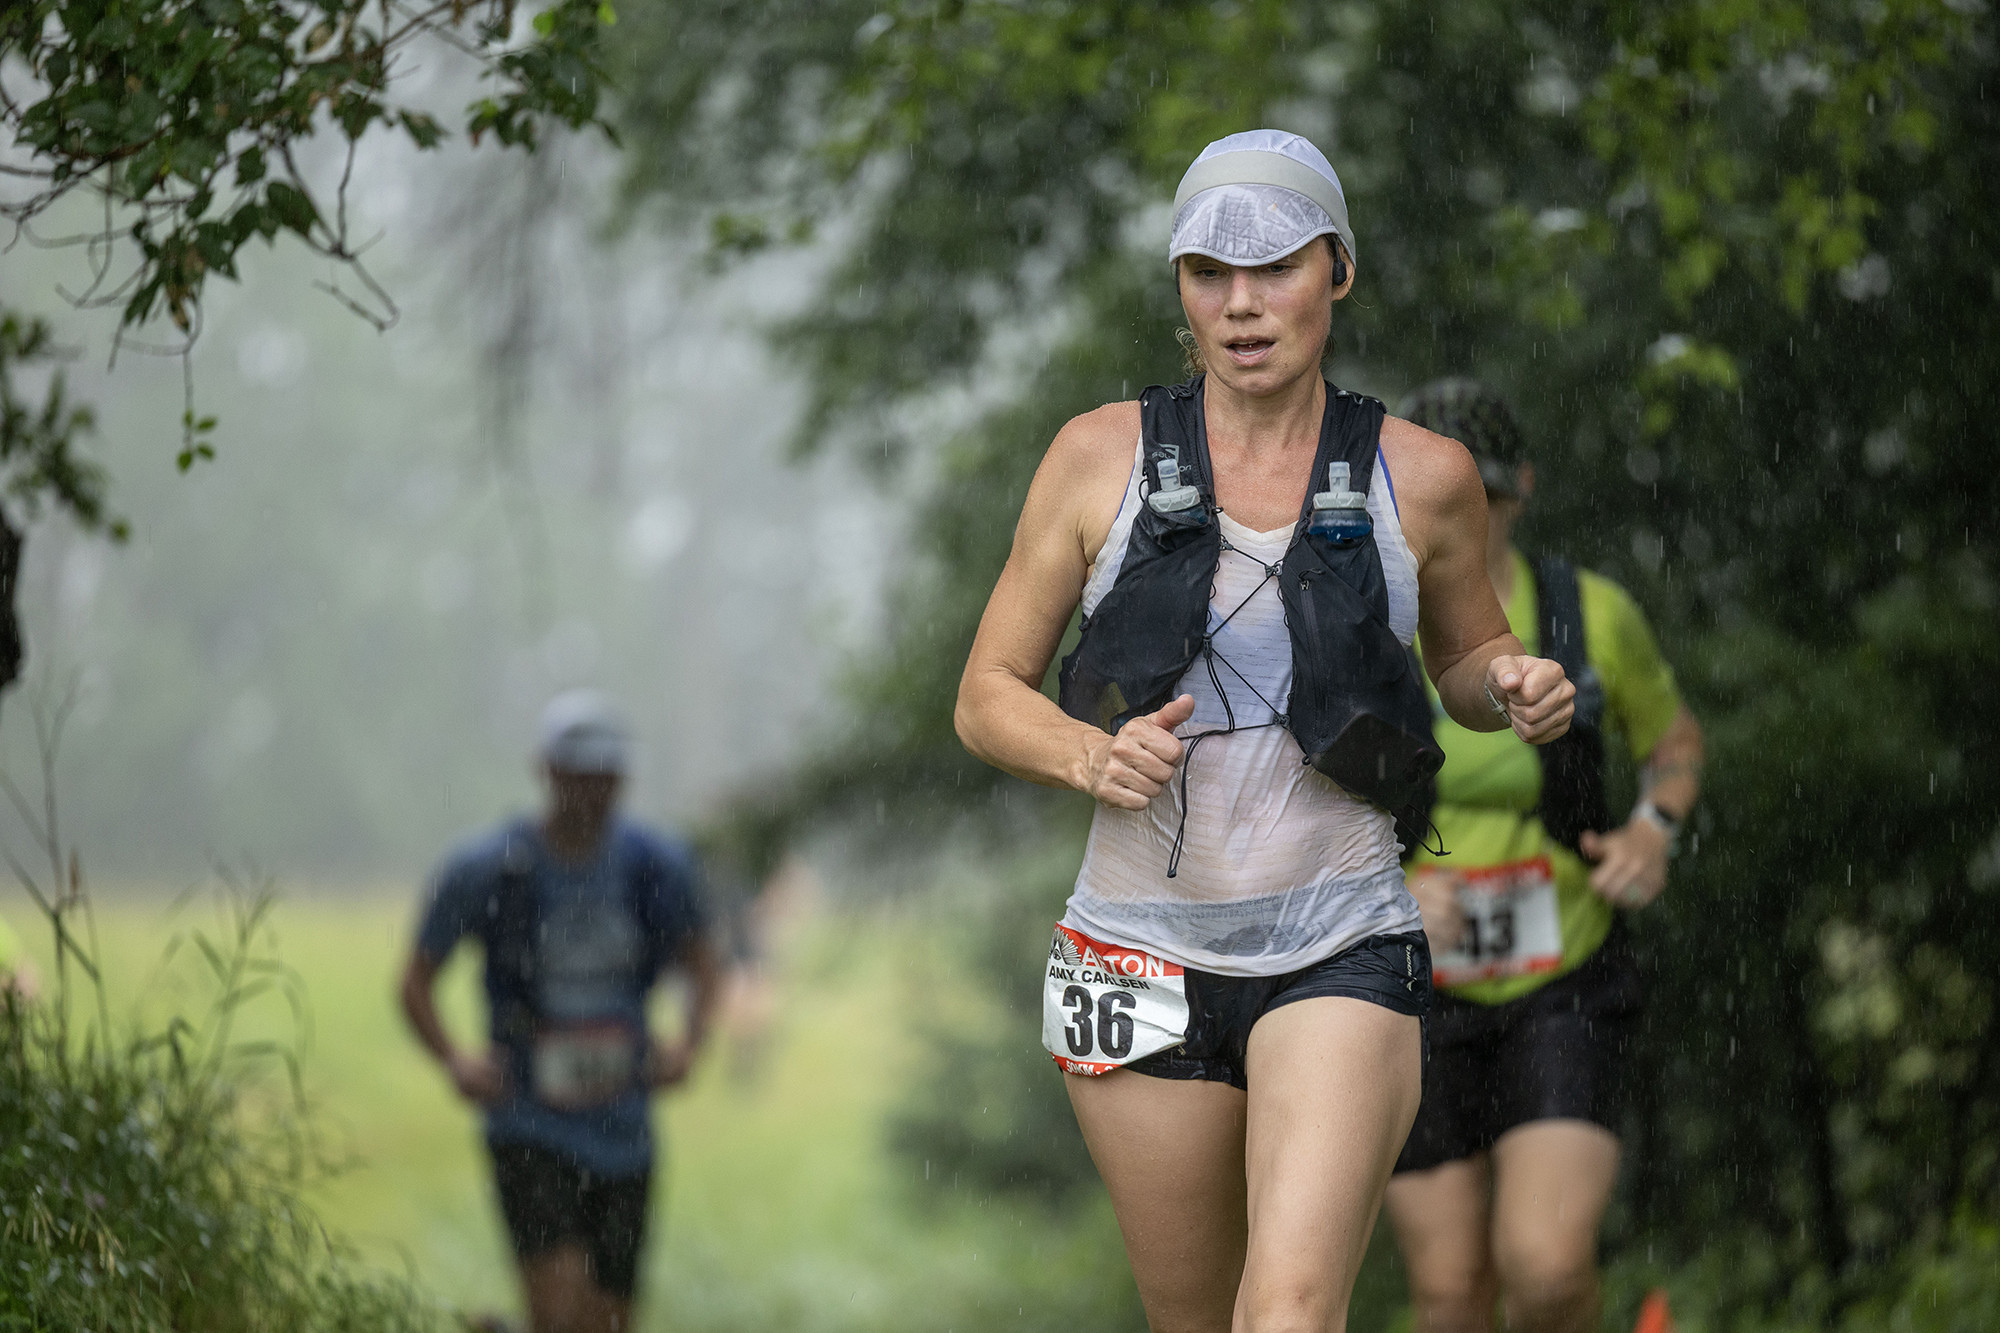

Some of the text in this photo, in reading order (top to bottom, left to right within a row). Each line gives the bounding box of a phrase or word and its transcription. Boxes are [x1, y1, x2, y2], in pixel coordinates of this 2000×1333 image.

[1151, 451, 1191, 472] salon
[1049, 965, 1150, 990] AMY CARLSEN
[1062, 984, 1136, 1059] 36
[1066, 1060, 1095, 1076] 50KM
